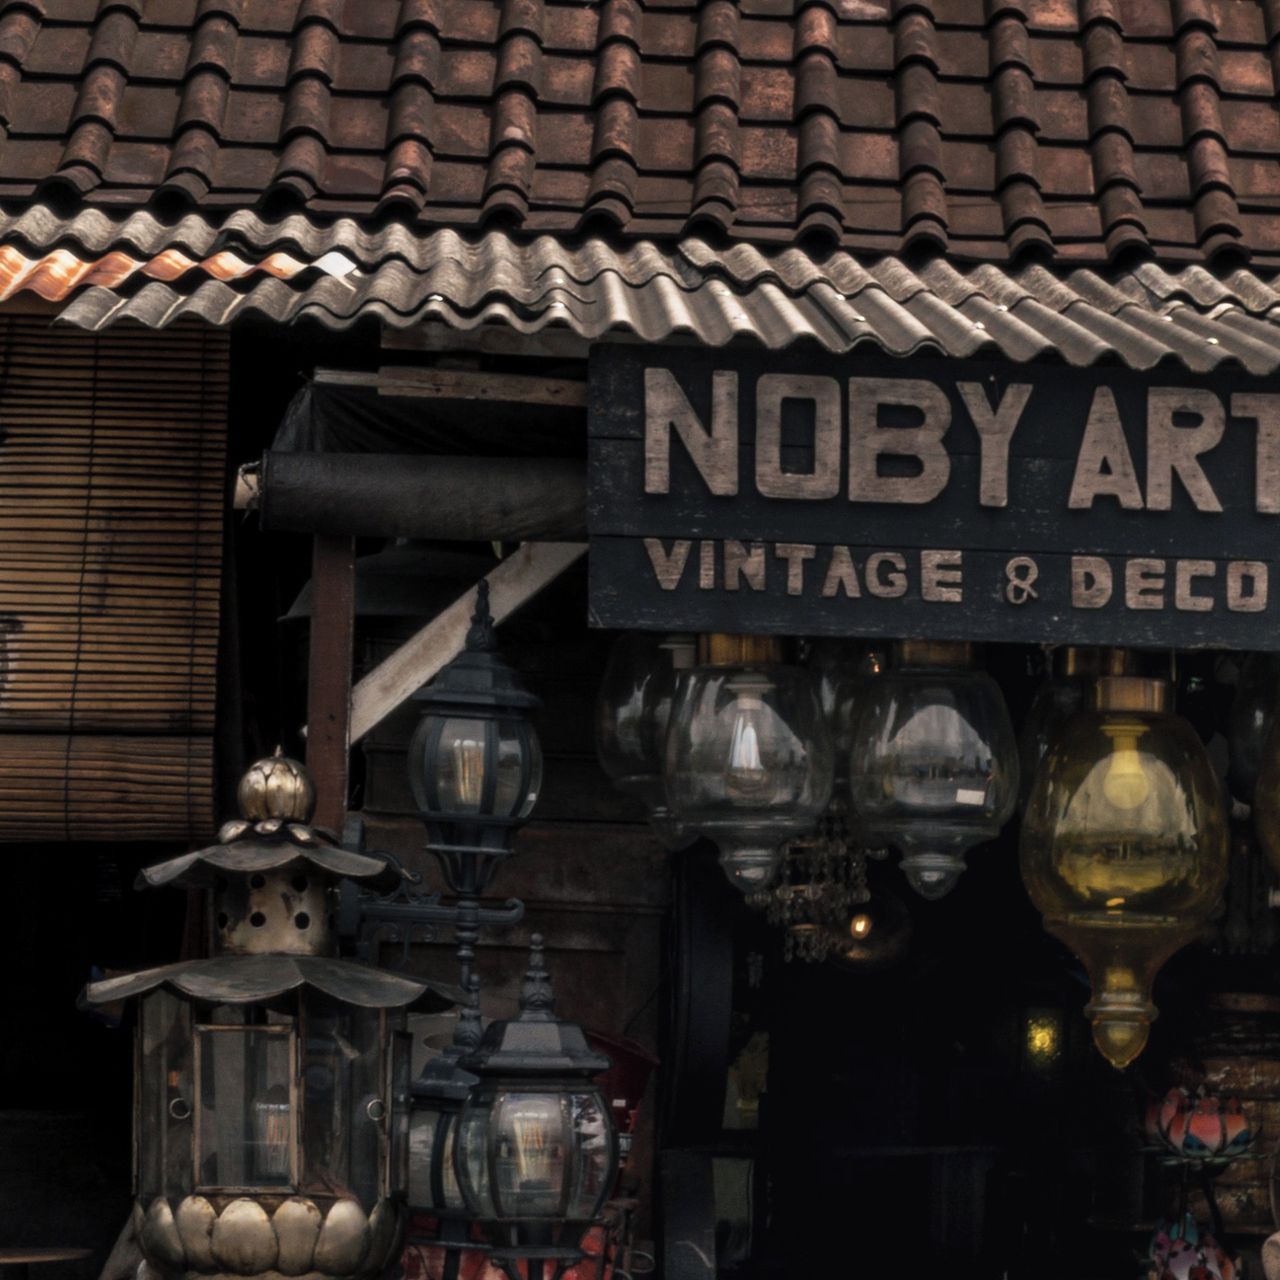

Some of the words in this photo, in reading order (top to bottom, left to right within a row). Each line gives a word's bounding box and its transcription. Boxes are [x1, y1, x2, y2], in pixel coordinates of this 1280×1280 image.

[643, 366, 1034, 509] NOBY
[643, 537, 964, 603] VINTAGE
[1004, 555, 1040, 606] &
[1070, 556, 1269, 613] DECO
